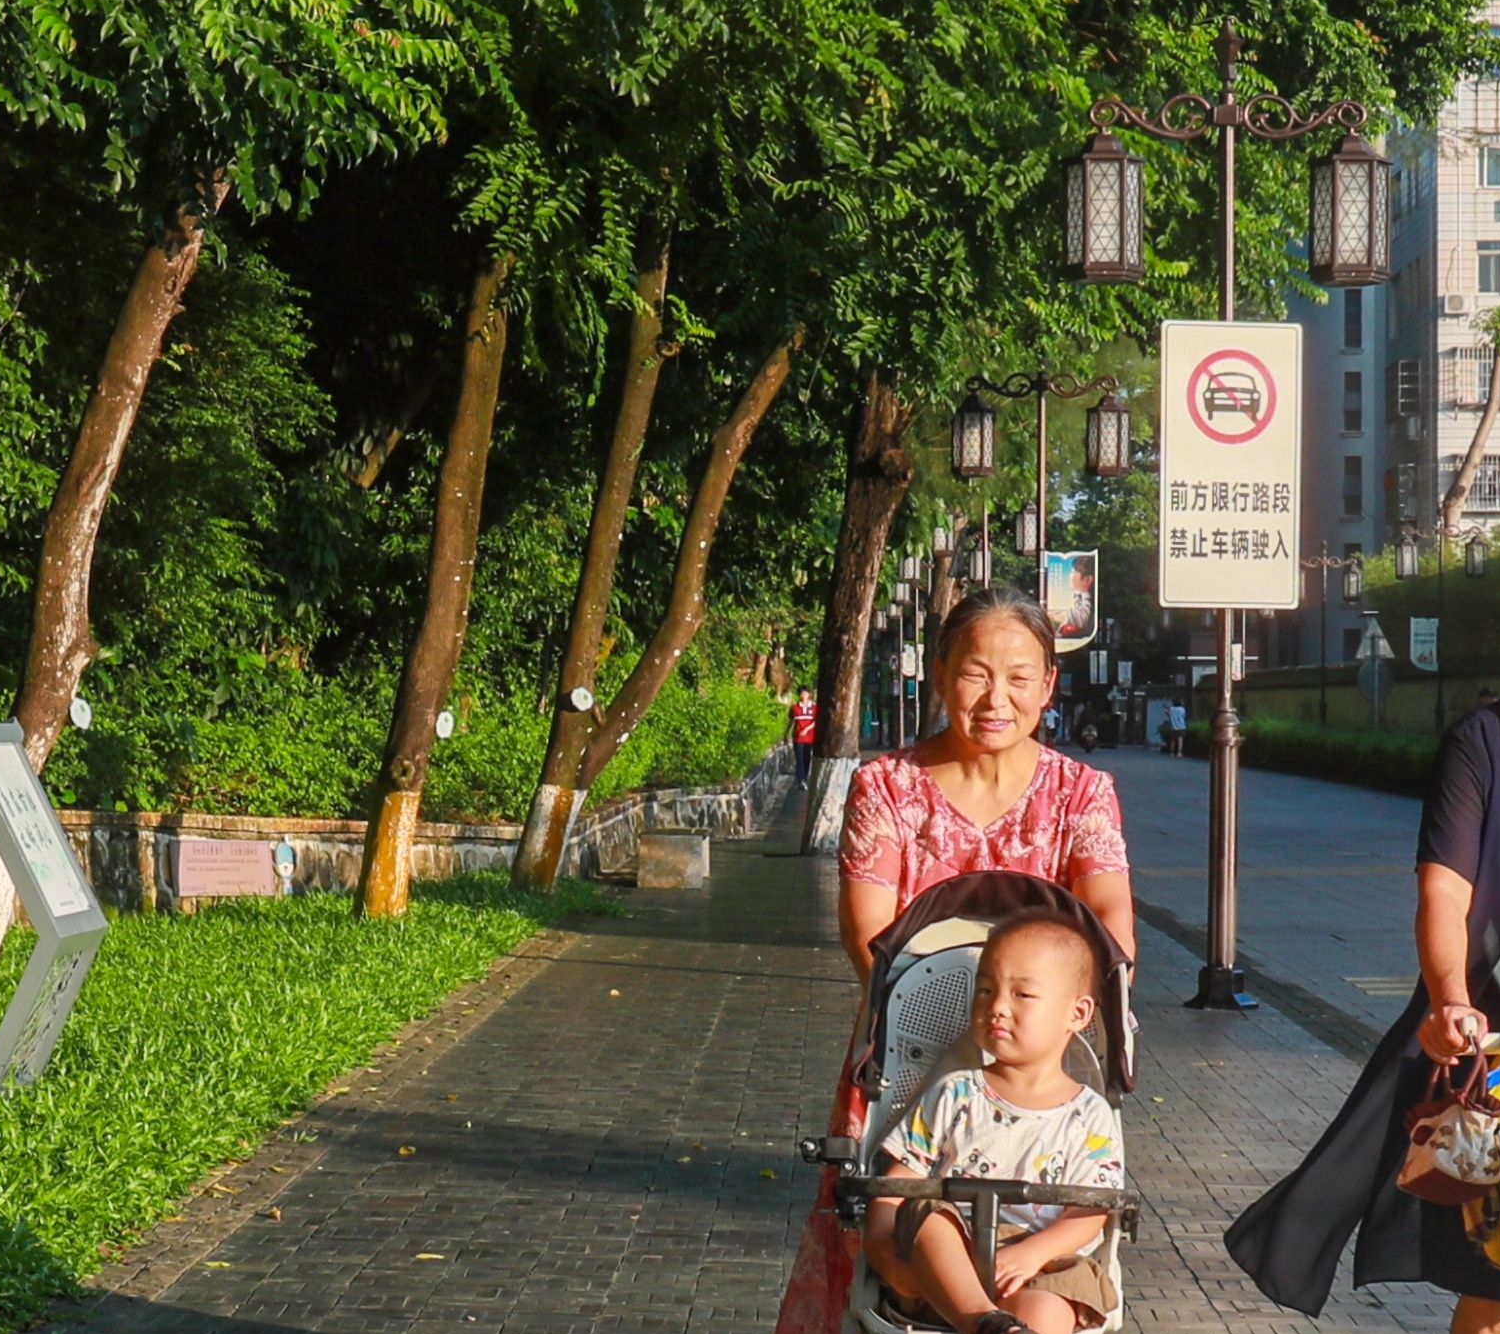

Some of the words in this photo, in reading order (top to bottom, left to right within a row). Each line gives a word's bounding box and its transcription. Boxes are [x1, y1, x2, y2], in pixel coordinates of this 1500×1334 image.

[1169, 479, 1291, 514] 前方限行路段
[1169, 527, 1290, 561] 禁止车辆驶入
